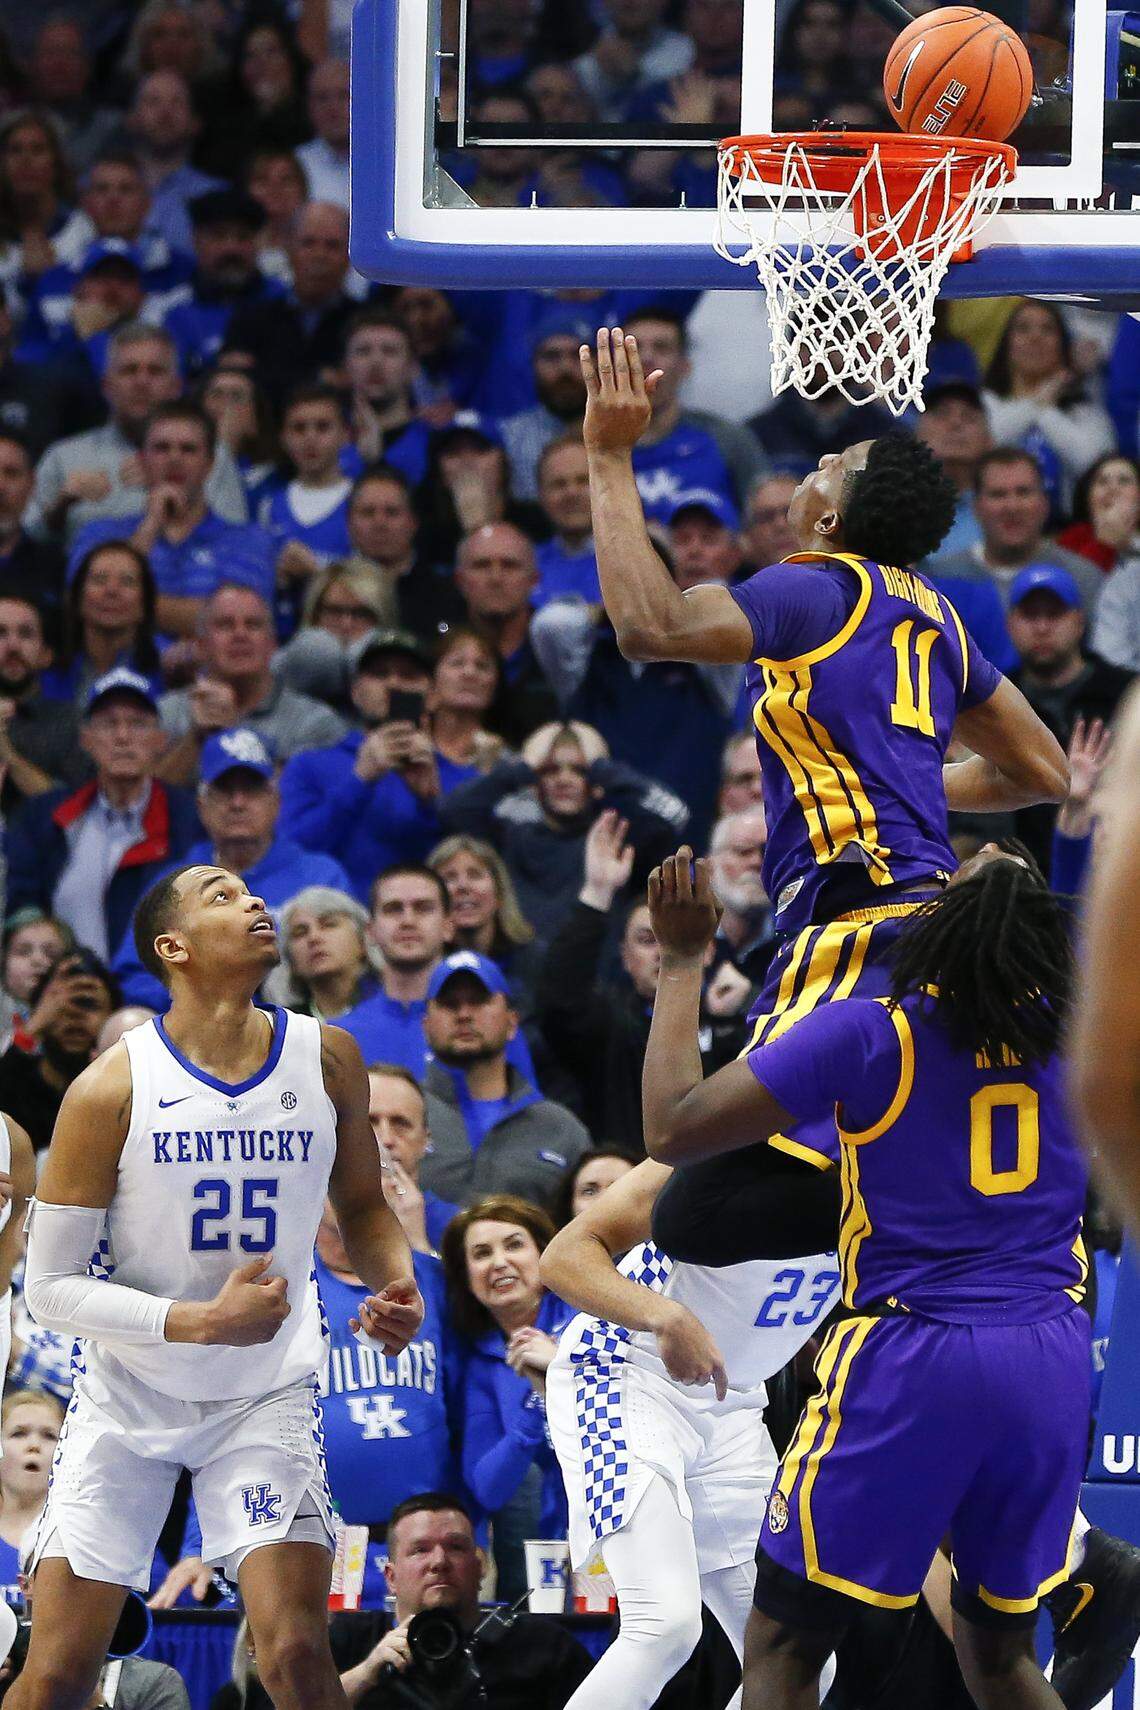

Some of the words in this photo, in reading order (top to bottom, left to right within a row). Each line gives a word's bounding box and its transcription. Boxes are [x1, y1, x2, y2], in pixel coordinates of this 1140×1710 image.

[921, 78, 967, 135] ELITE
[890, 619, 941, 738] 11
[152, 1130, 314, 1163] KENTUCKY
[970, 1082, 1040, 1197] 0
[191, 1178, 279, 1253] 25
[754, 1268, 840, 1327] 23
[345, 1394, 412, 1440] UK
[241, 1482, 281, 1527] UK
